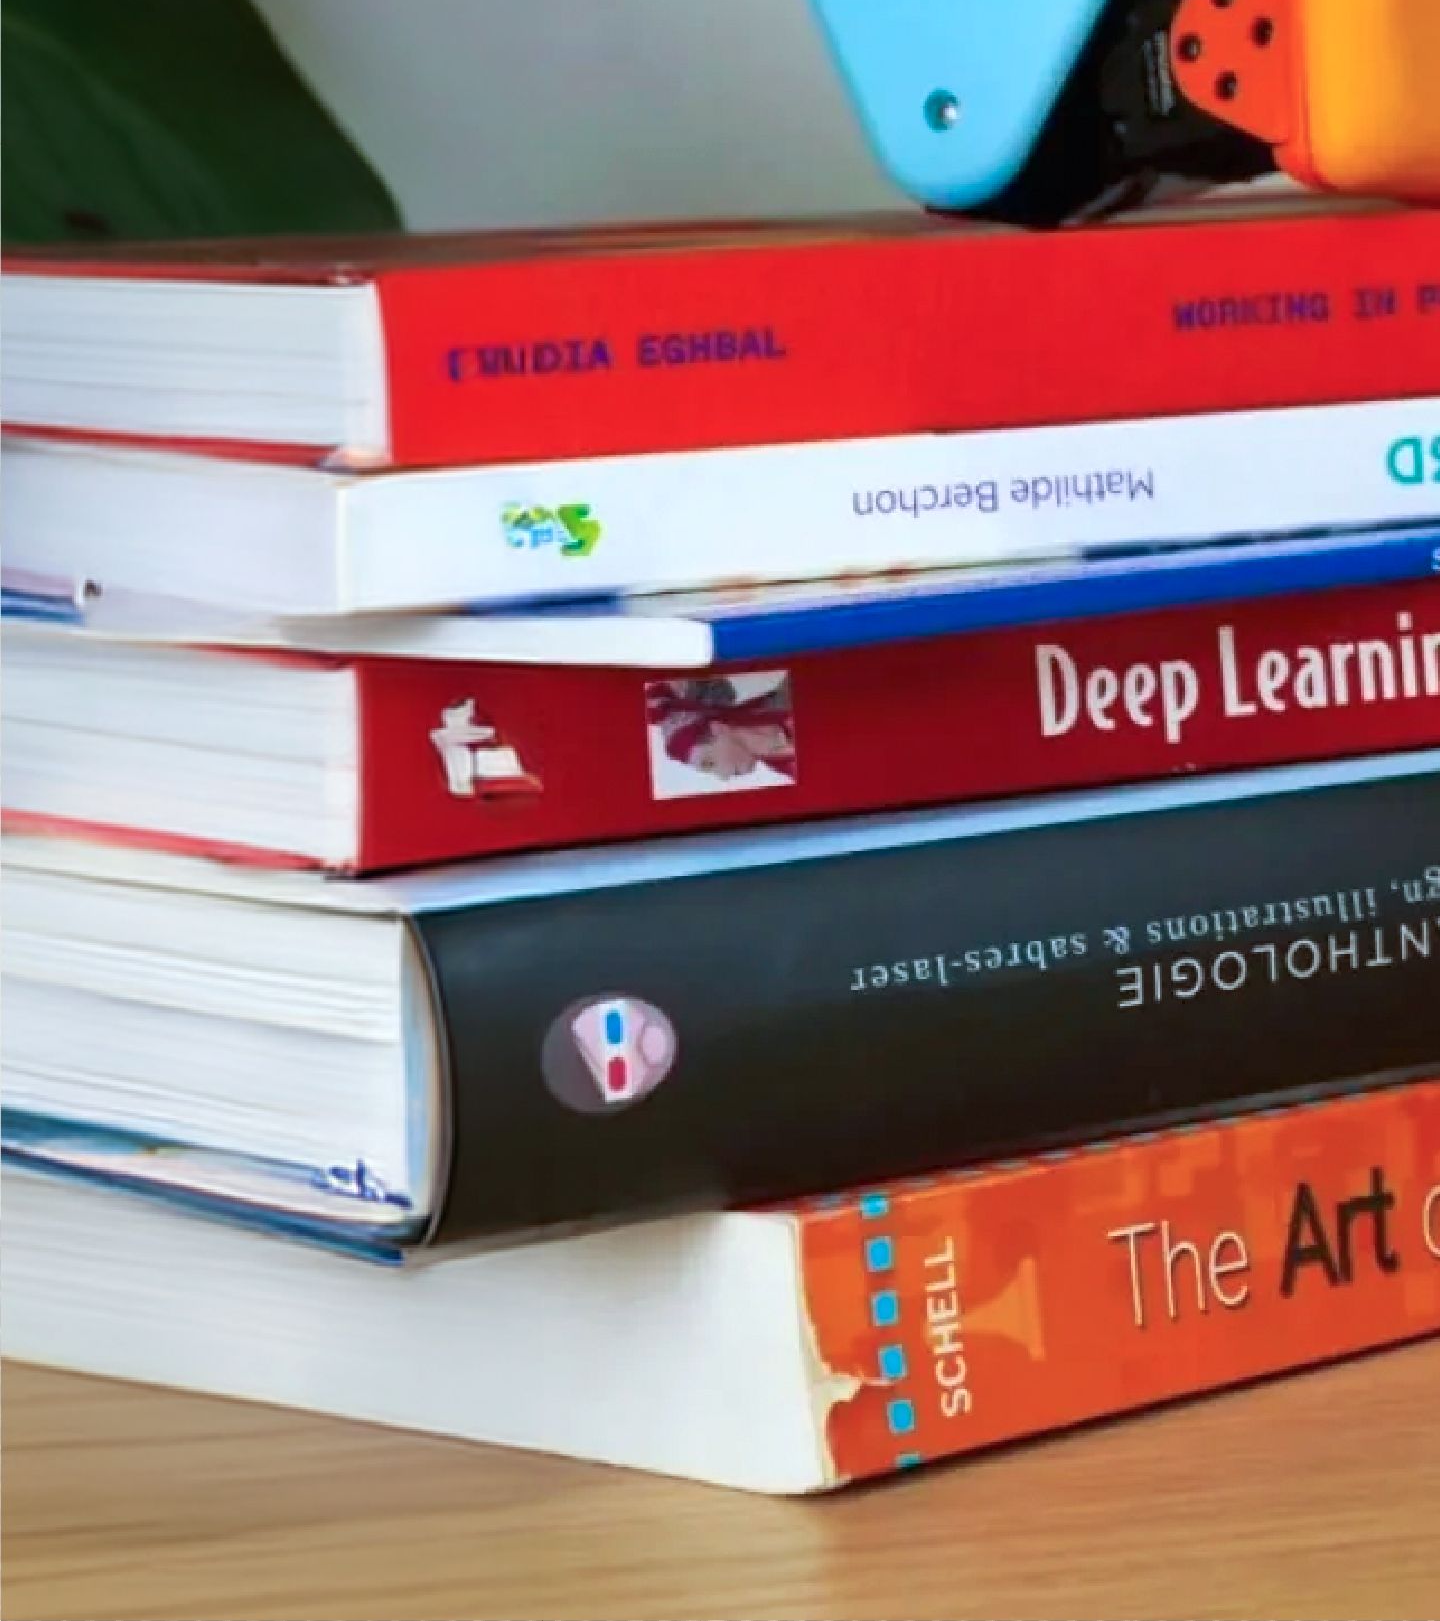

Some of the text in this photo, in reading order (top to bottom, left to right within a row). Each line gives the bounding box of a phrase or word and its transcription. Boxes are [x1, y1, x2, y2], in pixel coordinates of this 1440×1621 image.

[1173, 291, 1328, 330] WORKING
[1353, 287, 1397, 320] IN
[637, 326, 786, 366] EGHBAL
[852, 468, 1154, 518] Mathilde Berchon
[1035, 644, 1199, 744] Deep
[1103, 925, 1132, 956] &
[1145, 887, 1378, 945] illustrations
[849, 931, 1088, 992] sabres-laser
[1107, 1220, 1251, 1328] The
[1280, 1167, 1398, 1297] Art
[924, 1235, 973, 1418] SCHELL
